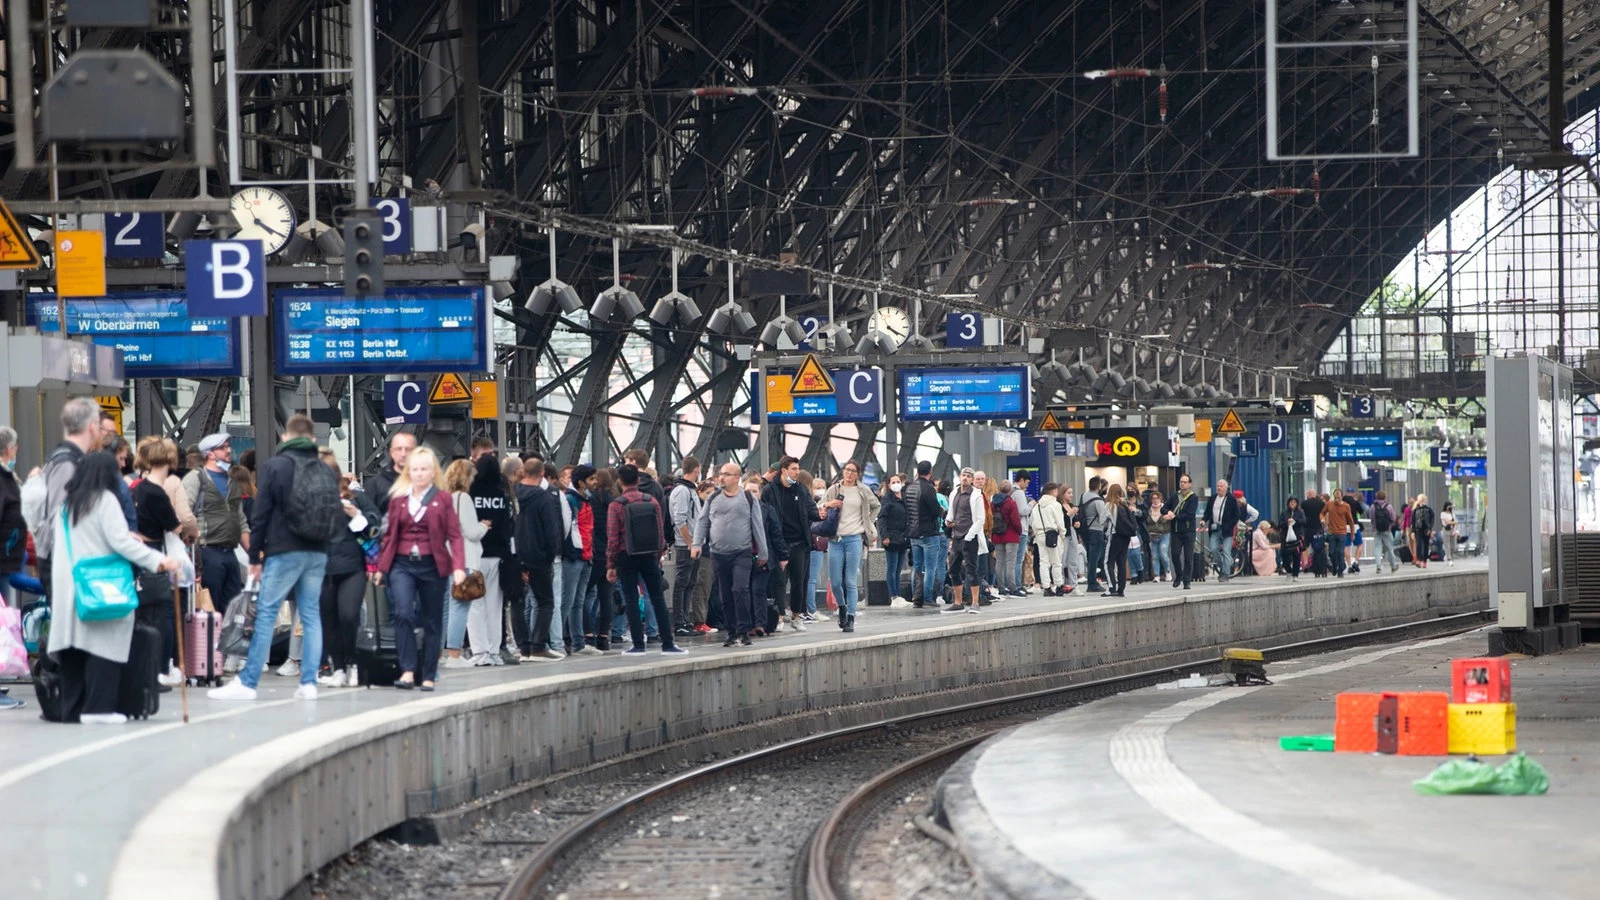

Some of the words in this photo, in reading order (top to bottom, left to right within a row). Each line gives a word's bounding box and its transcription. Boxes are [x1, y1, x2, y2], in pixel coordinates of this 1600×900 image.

[114, 212, 141, 245] 2
[376, 200, 402, 242] 3
[212, 242, 254, 298] B
[79, 320, 90, 330] W
[94, 320, 160, 330] Oberbarmen
[326, 316, 360, 329] Siegen
[803, 317, 819, 343] 2
[960, 314, 977, 340] 3
[362, 340, 384, 348] Berlin
[386, 340, 399, 348] Hbf
[138, 354, 152, 362] Hbf
[362, 350, 384, 358] Berlin
[849, 372, 873, 404] C
[398, 382, 421, 414] C
[1360, 398, 1370, 413] 3
[1268, 424, 1282, 443] D
[1438, 448, 1448, 462] E
